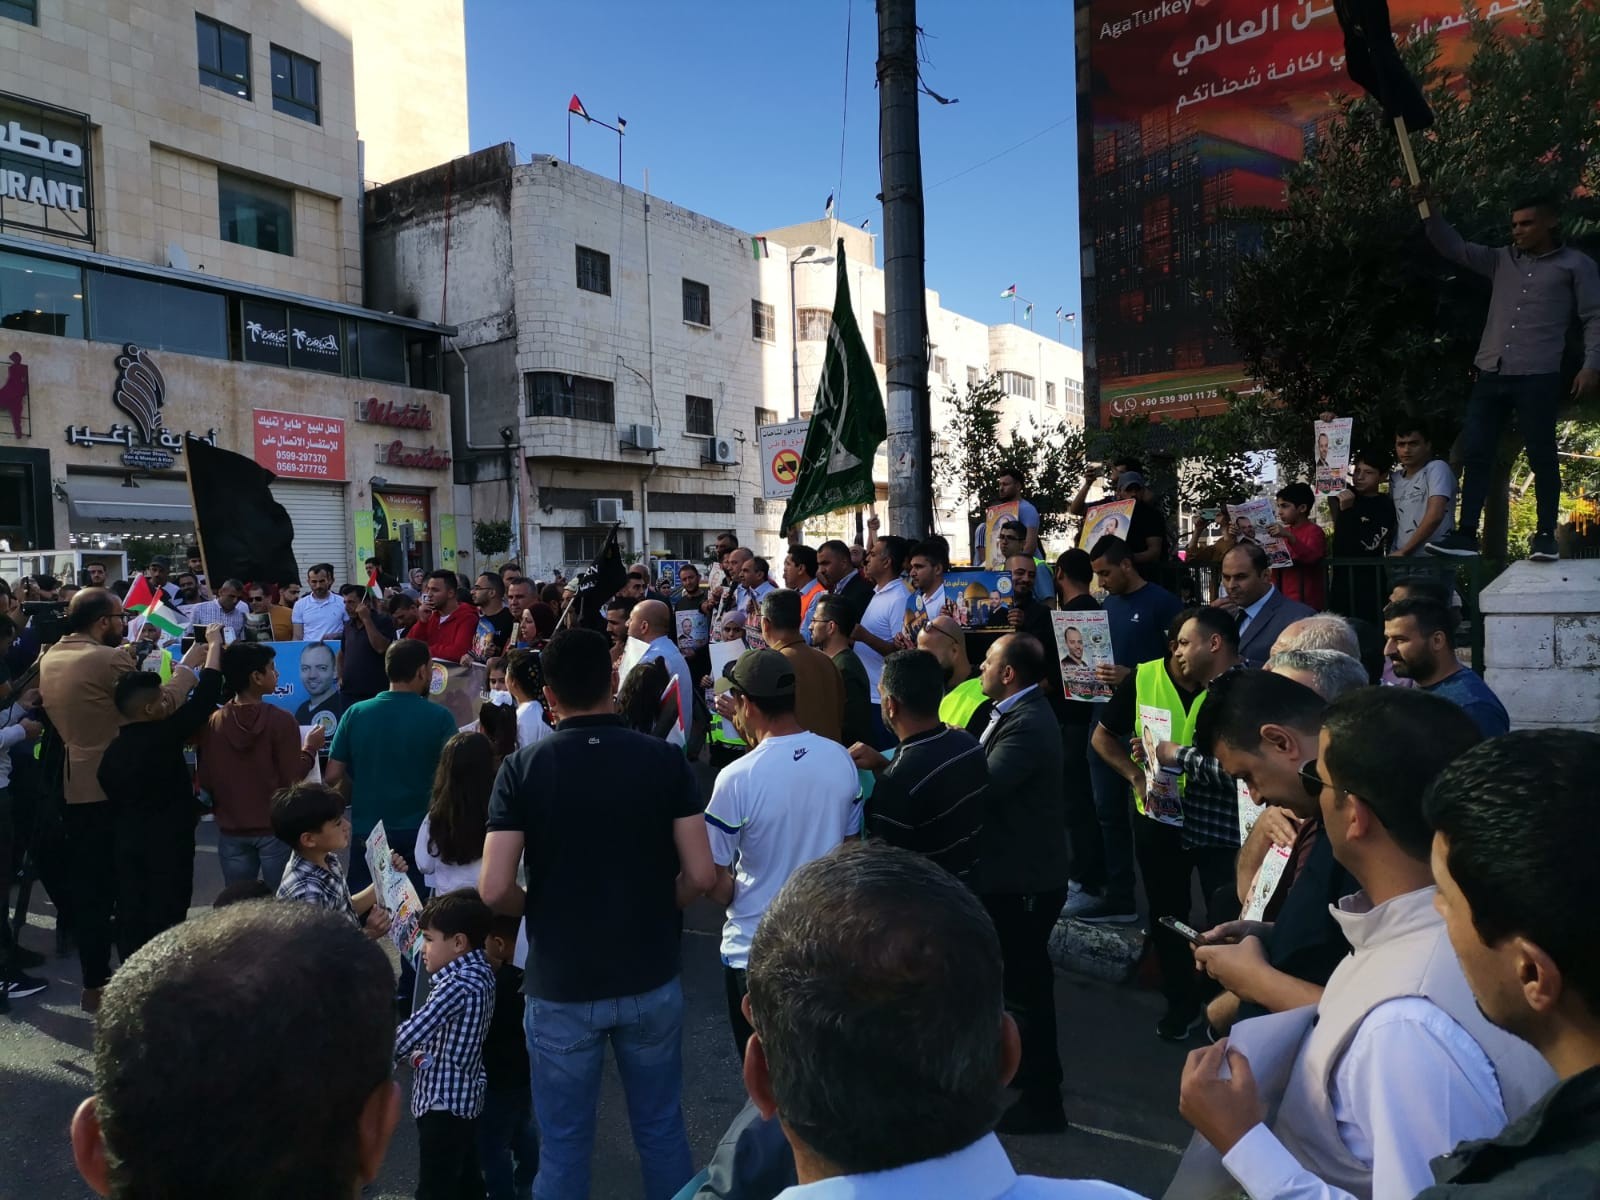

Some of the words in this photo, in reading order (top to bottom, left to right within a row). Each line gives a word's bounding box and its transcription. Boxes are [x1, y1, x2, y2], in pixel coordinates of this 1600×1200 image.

[1172, 5, 1279, 76] العالمي
[1267, 51, 1323, 80] لكافة
[1176, 70, 1261, 113] شحناتكم
[1141, 398, 1157, 407] +90
[1159, 395, 1175, 405] 539
[1177, 393, 1193, 402] 301
[1195, 391, 1205, 400] 11
[1206, 389, 1218, 399] 75
[258, 416, 279, 428] تمليك
[307, 421, 323, 434] للبيع
[325, 422, 340, 434] المحل
[70, 425, 132, 447] زغير
[276, 451, 326, 463] 0599-297370
[277, 463, 327, 475] 0569-277752
